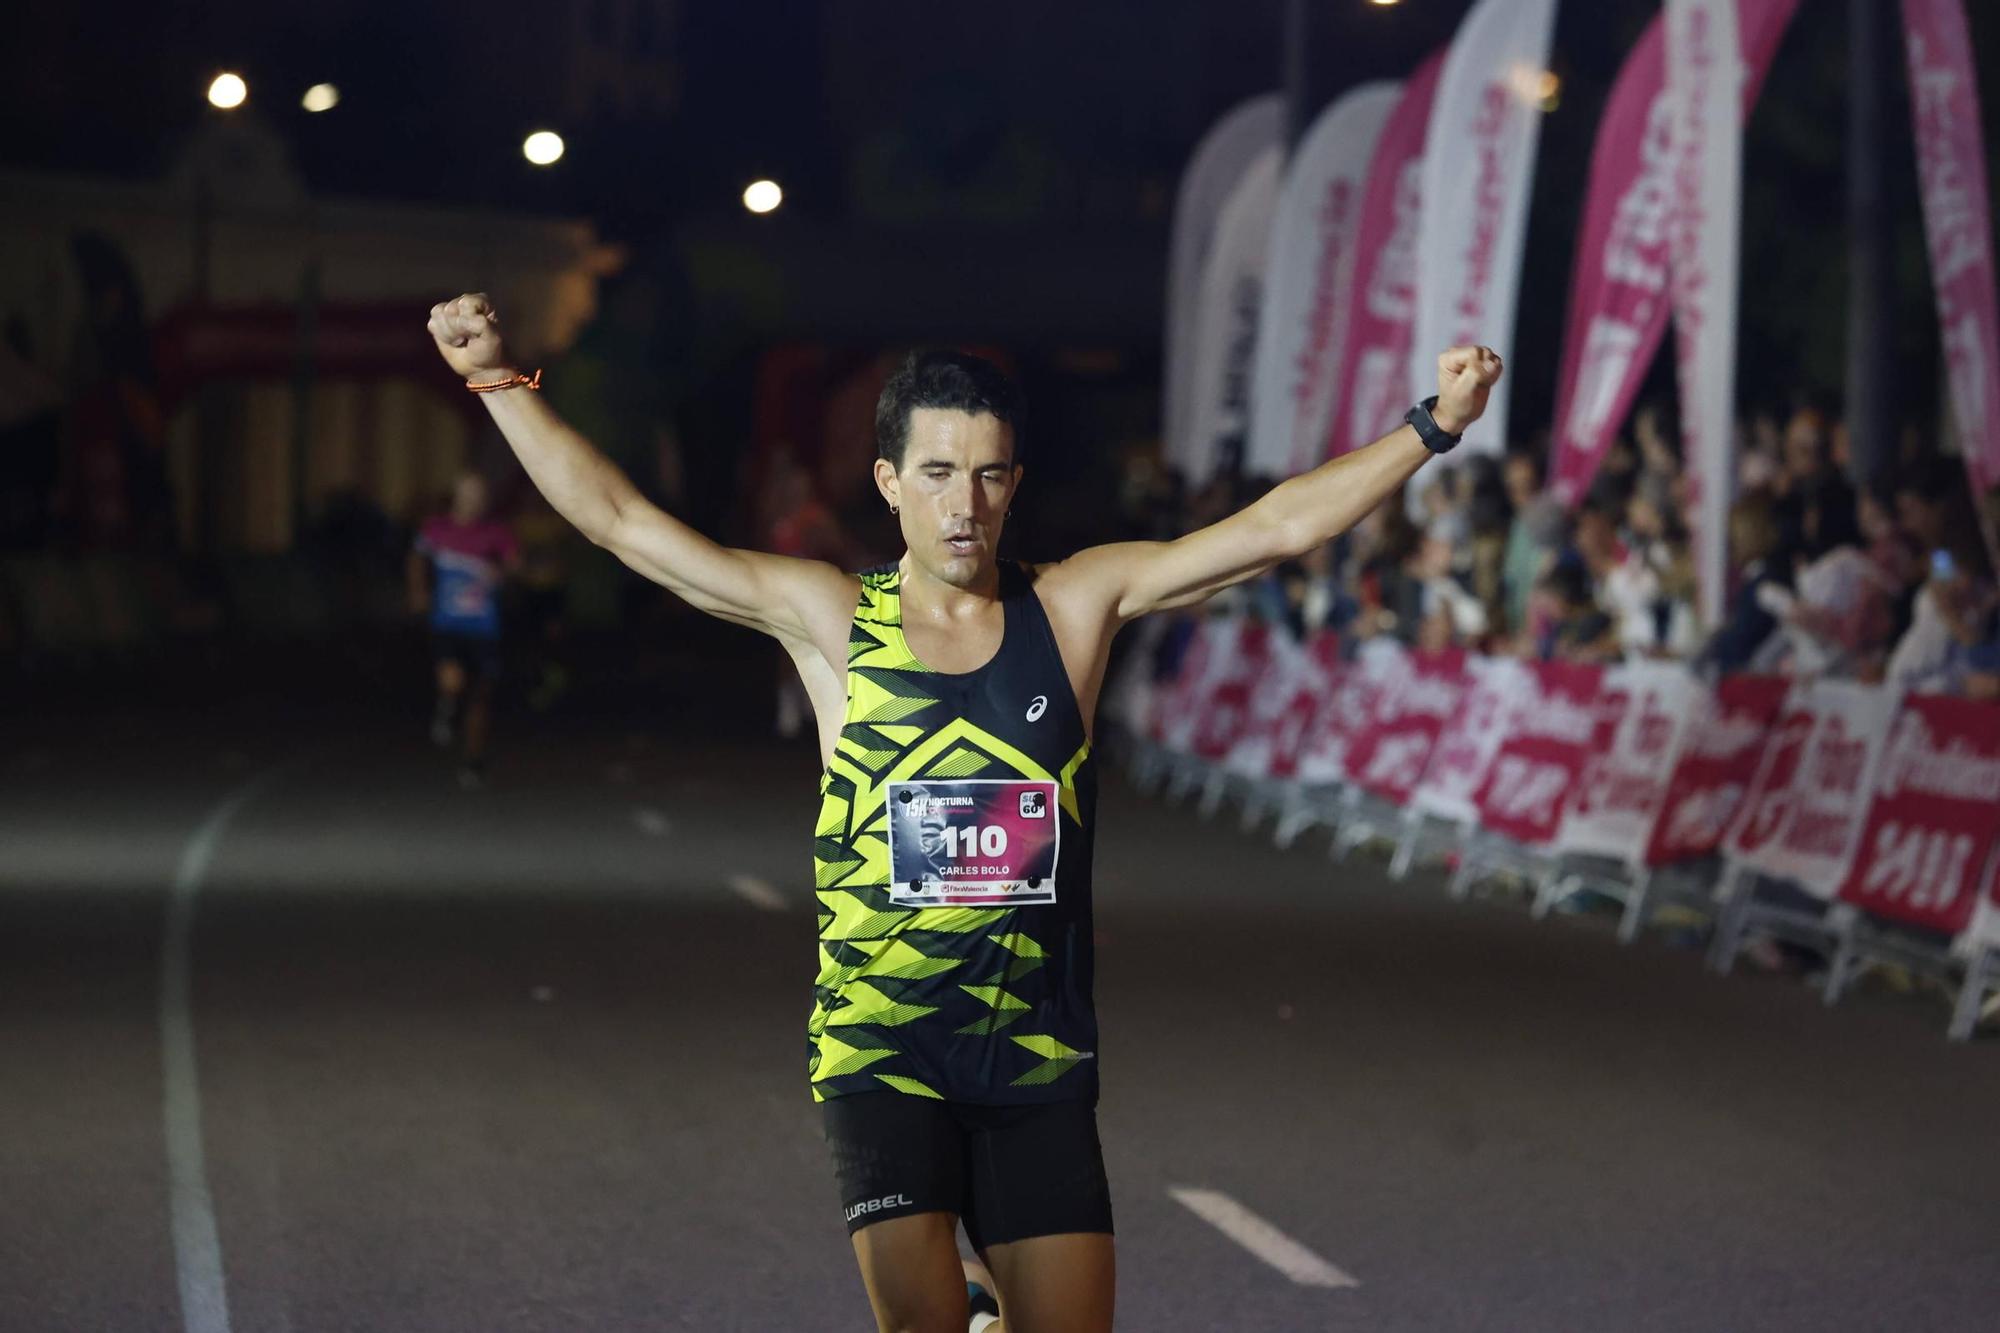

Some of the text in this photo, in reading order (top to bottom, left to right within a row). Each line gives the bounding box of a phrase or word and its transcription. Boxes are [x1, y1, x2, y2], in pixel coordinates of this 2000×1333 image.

[906, 798, 928, 817] 15K
[928, 797, 974, 806] NOCTURNA
[940, 825, 1007, 857] 110
[939, 865, 1010, 875] CARLES BOLO
[845, 1194, 913, 1221] LURBEL
